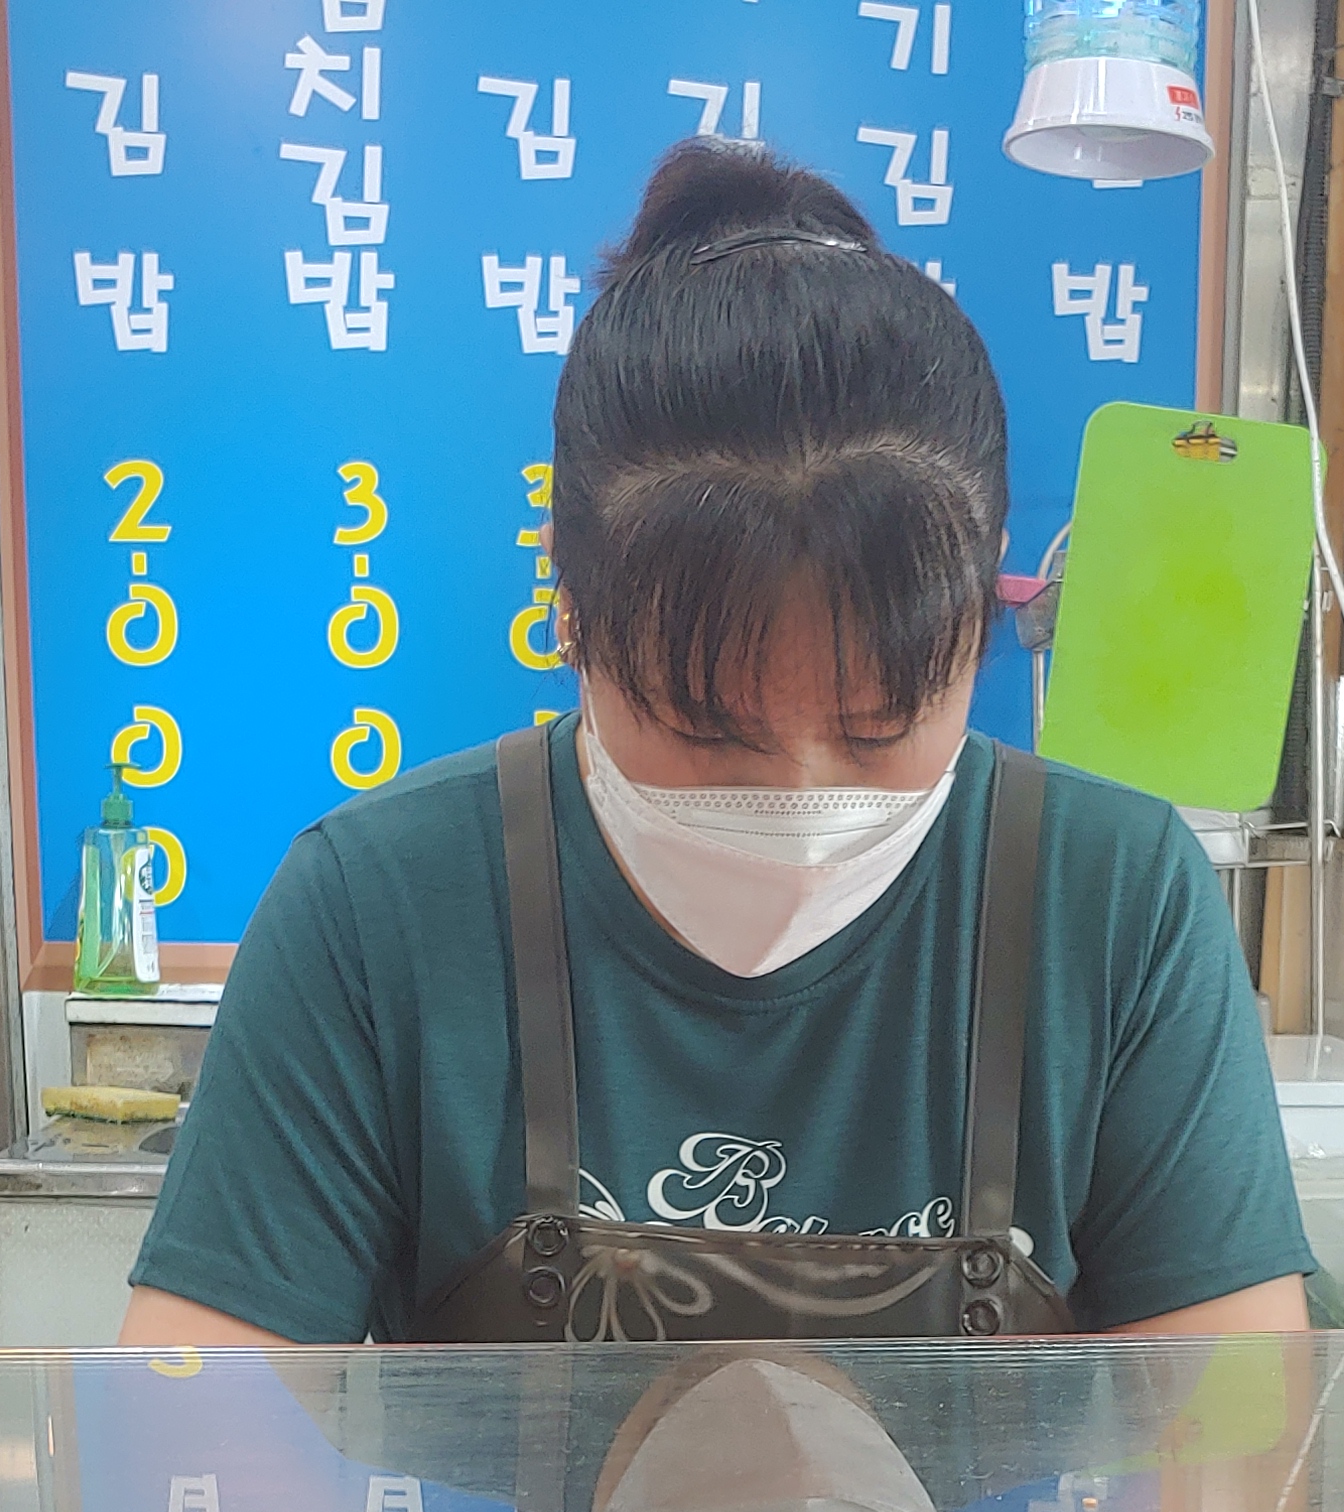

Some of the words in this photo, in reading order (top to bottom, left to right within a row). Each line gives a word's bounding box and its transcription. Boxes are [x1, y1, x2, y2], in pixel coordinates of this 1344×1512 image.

[66, 72, 174, 353] 김밥
[280, 0, 395, 351] 치김밥
[477, 76, 581, 355] 김밥
